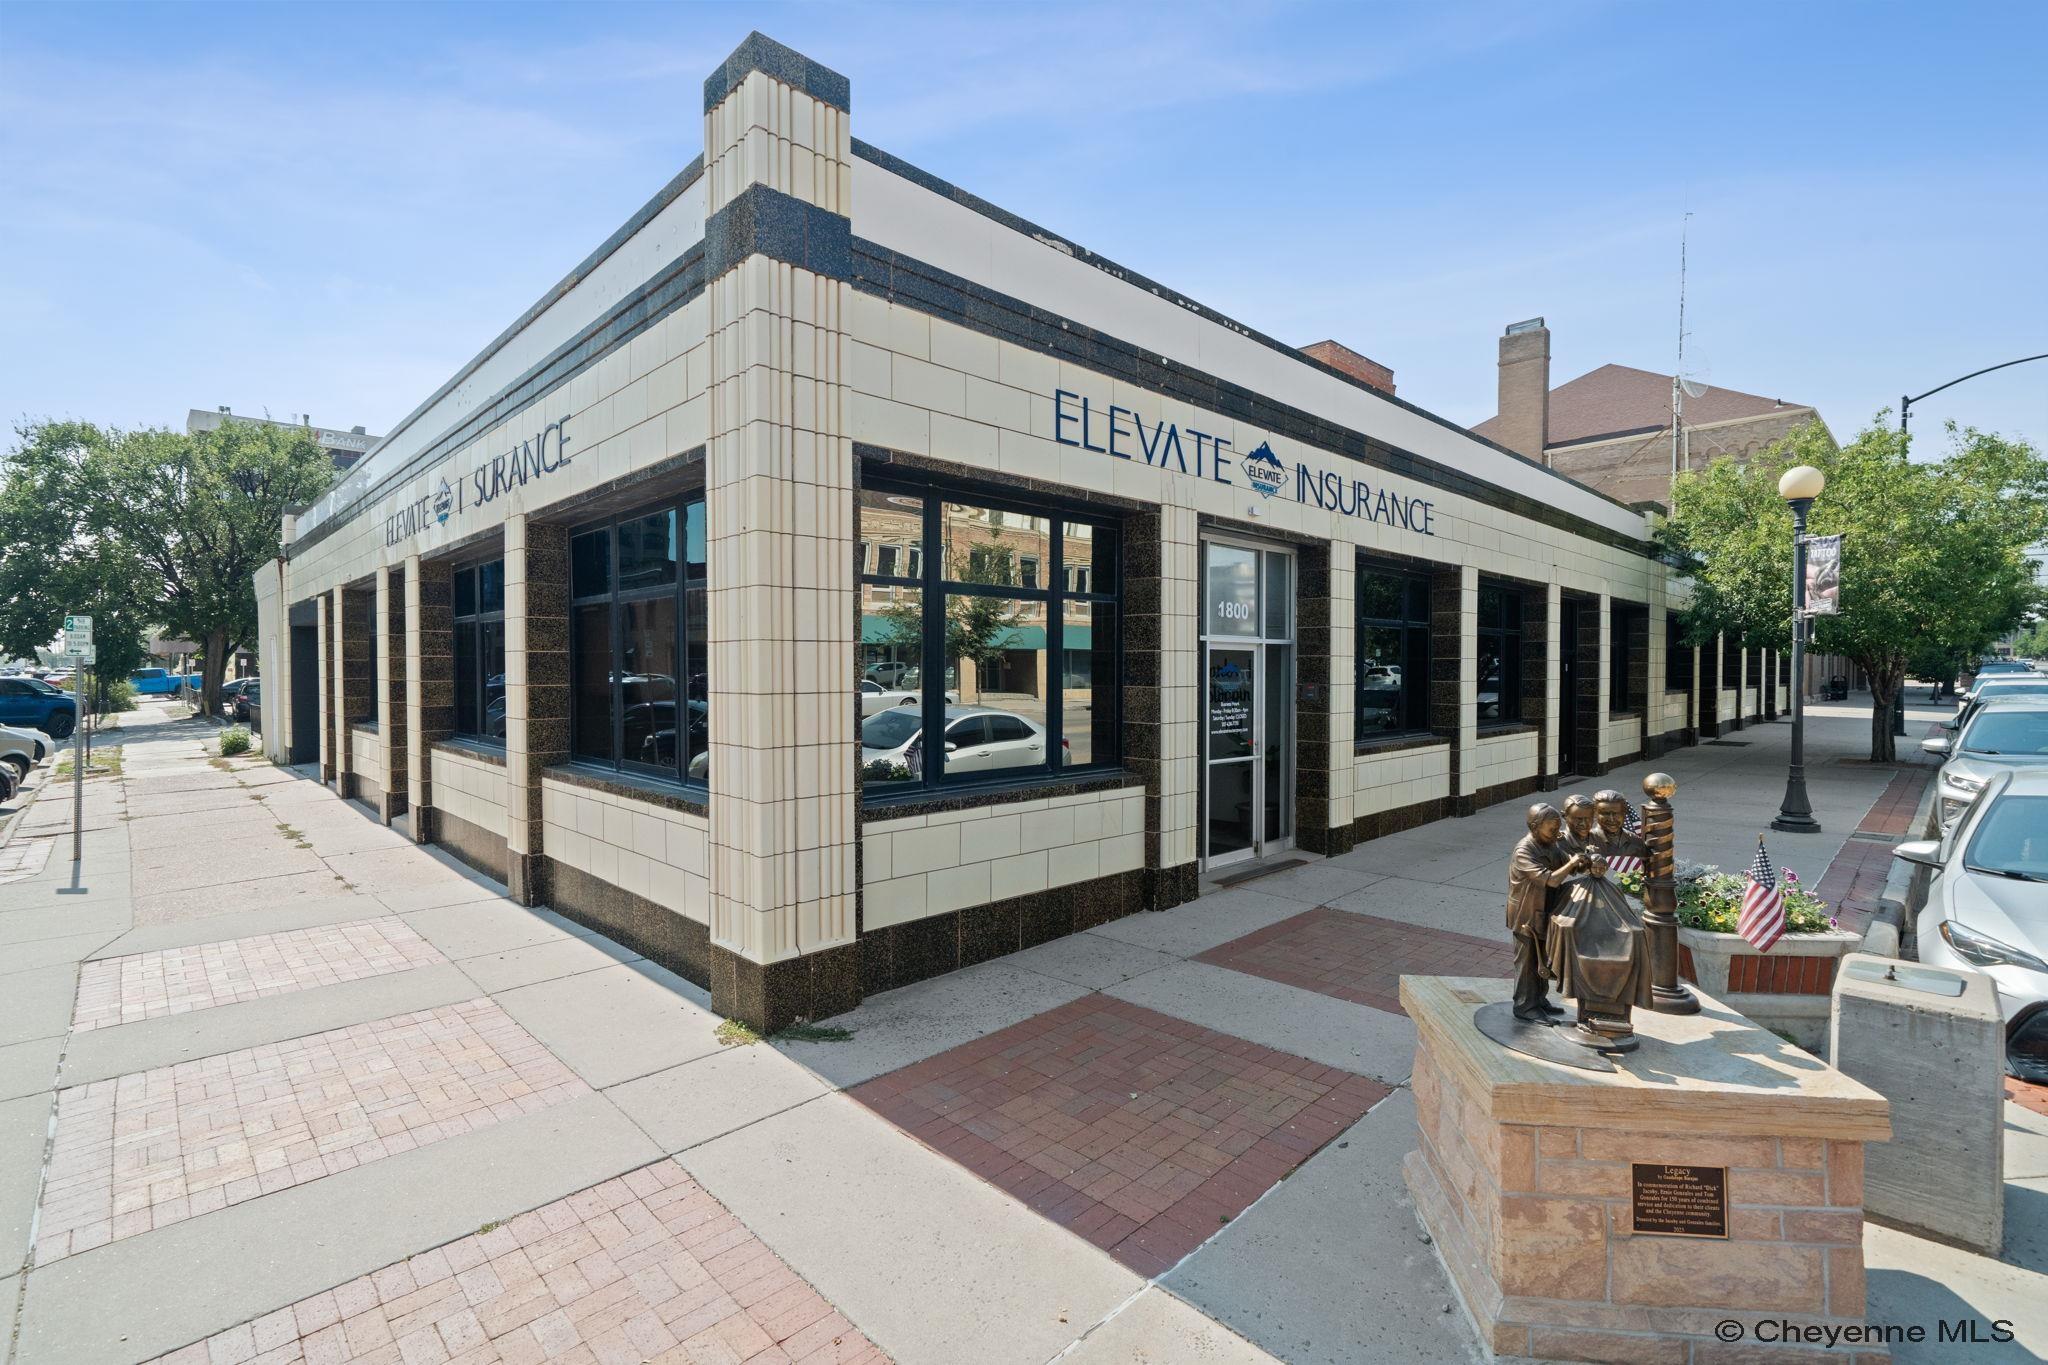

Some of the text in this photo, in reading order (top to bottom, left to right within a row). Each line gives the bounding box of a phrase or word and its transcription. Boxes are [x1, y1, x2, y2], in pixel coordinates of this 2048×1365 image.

[322, 432, 367, 450] BANK
[1056, 389, 1434, 535] ELEVATE INSURANCE
[1248, 465, 1282, 484] ELEVATE
[386, 495, 430, 547] ELEVATE
[1218, 600, 1248, 620] 1800
[66, 620, 73, 630] 2
[1665, 1166, 1691, 1176] Legacy
